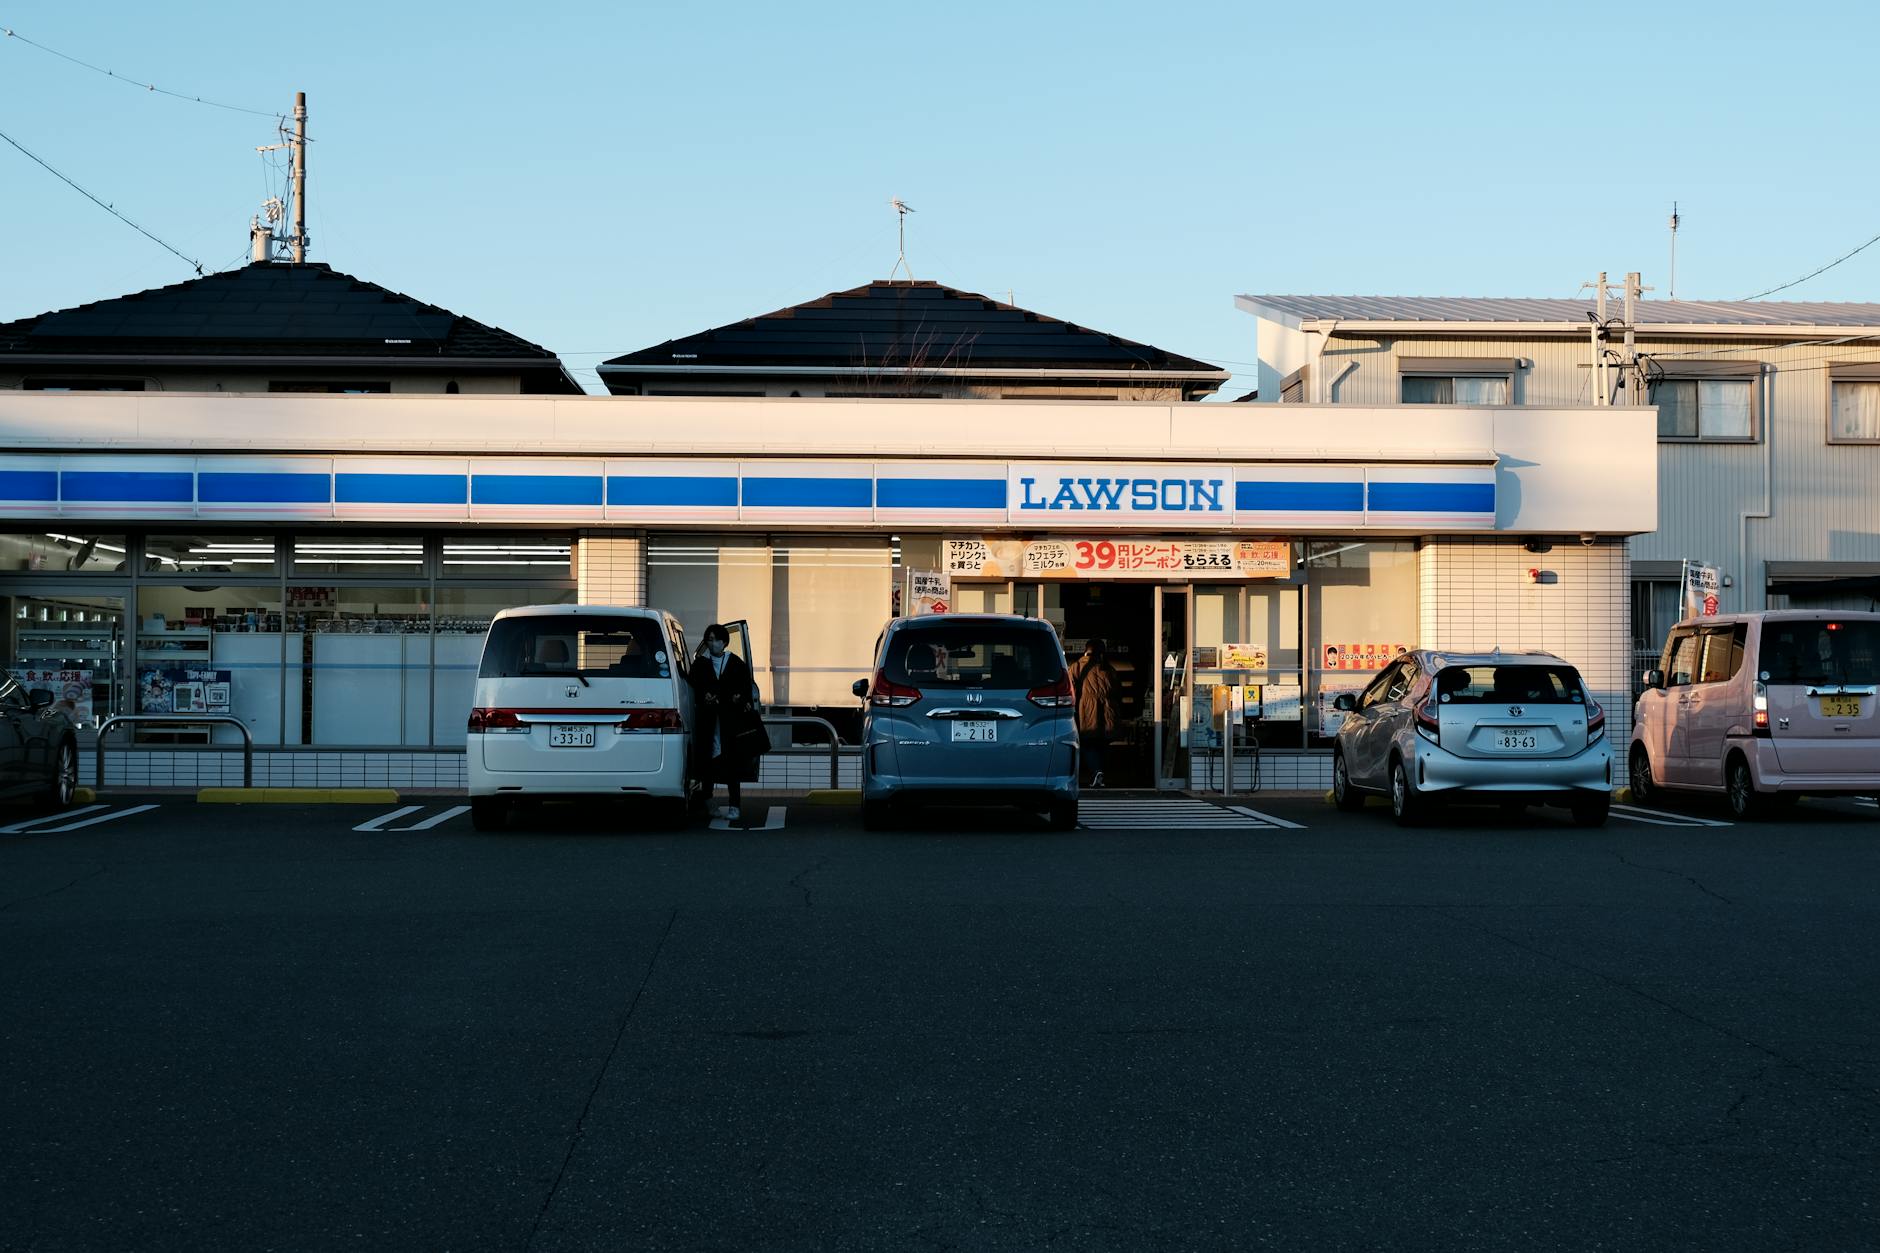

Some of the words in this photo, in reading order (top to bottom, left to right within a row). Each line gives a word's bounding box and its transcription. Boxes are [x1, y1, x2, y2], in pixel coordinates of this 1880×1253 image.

[1020, 477, 1223, 511] LAWSON
[1075, 541, 1116, 569] 39
[1118, 544, 1181, 556] 円レシート
[950, 561, 981, 570] を買うと
[1118, 556, 1182, 569] 引クーポン
[1183, 553, 1232, 566] もらえる
[1837, 703, 1860, 715] 235
[559, 733, 592, 745] 33-10
[1504, 736, 1536, 748] 83-63
